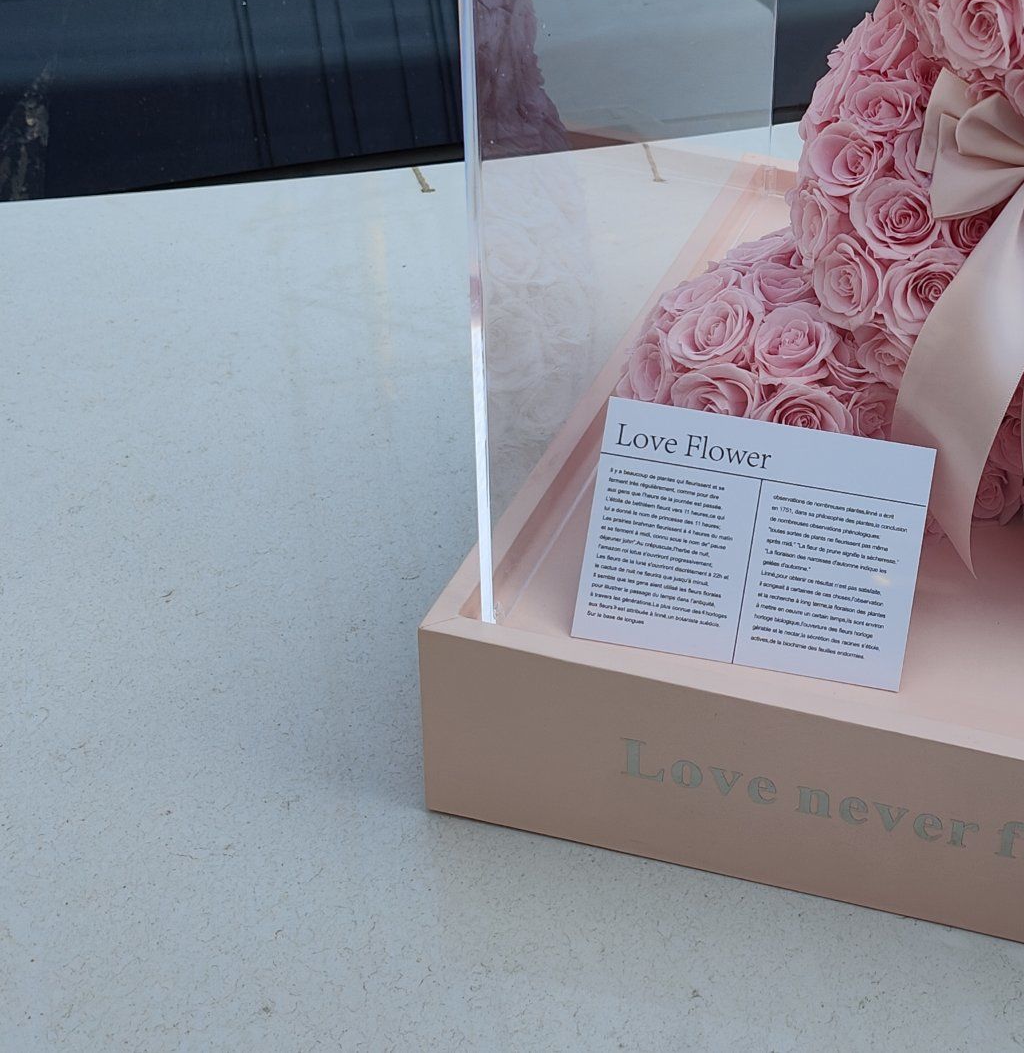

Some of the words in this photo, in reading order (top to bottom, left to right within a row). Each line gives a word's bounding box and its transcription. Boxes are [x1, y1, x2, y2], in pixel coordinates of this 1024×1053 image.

[616, 423, 678, 455] Love
[685, 434, 772, 470] Flower
[620, 737, 777, 805] Love
[794, 785, 979, 848] never
